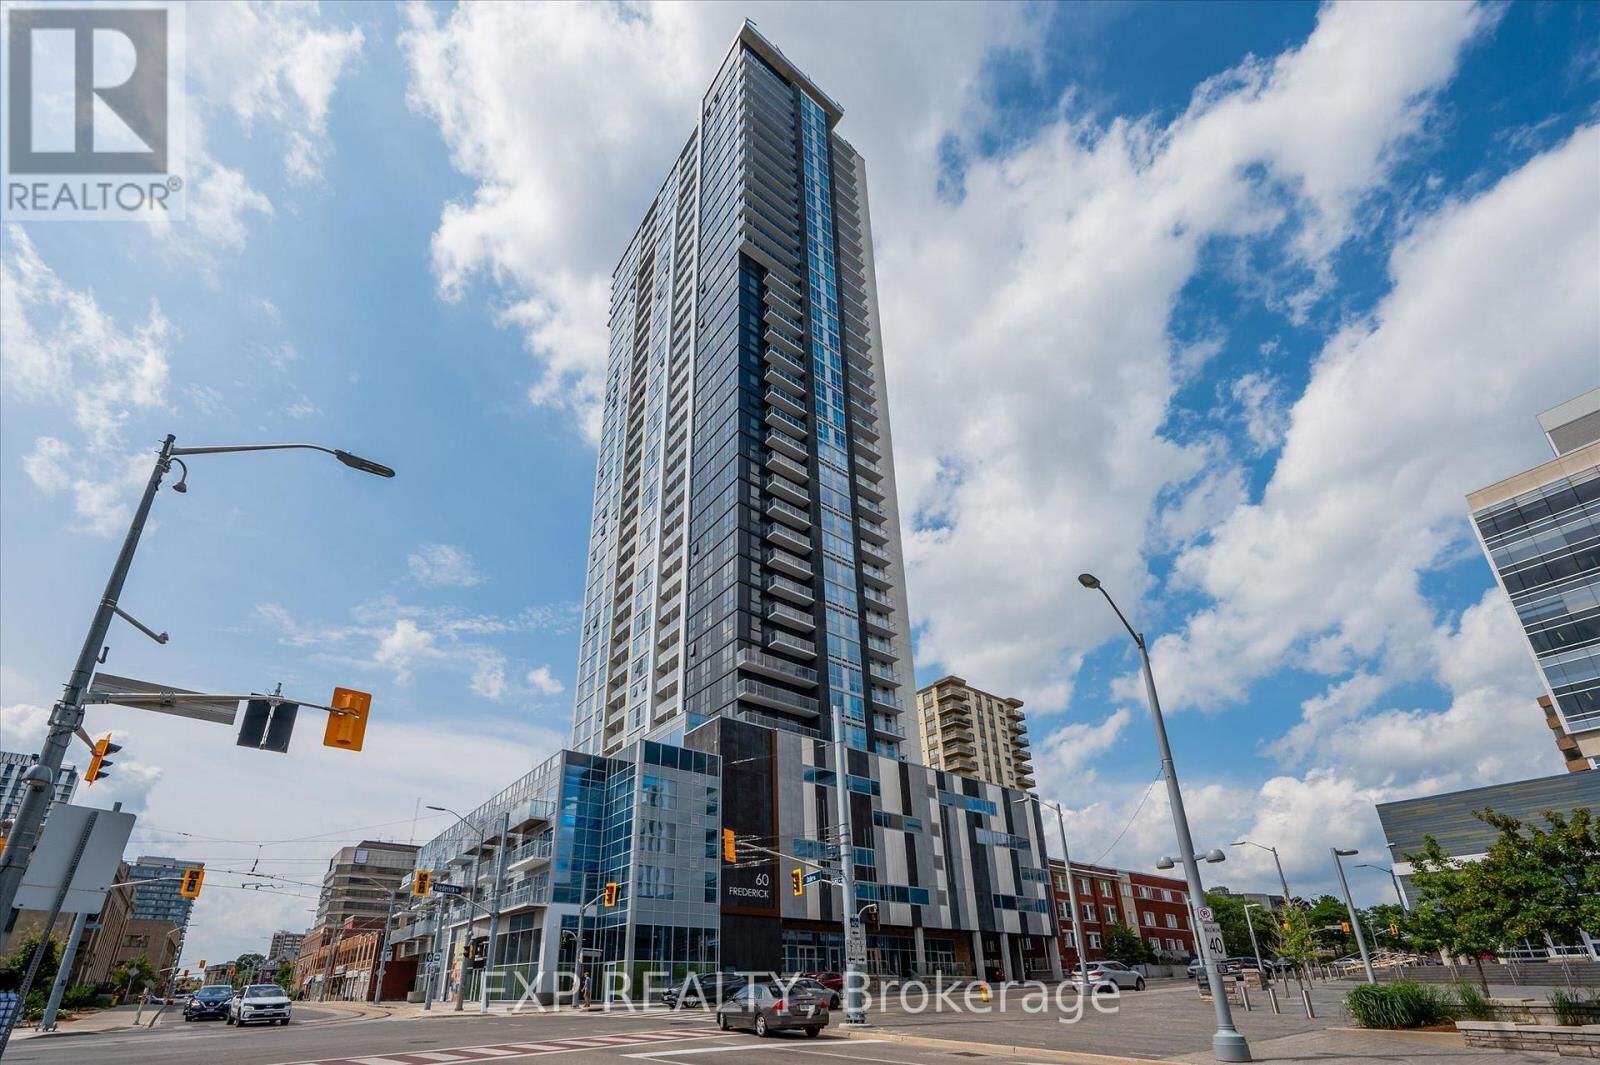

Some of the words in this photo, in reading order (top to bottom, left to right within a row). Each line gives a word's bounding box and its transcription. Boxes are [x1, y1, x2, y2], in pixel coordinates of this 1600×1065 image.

[755, 873, 769, 886] 60
[728, 886, 769, 898] FREDERICK
[1210, 937, 1223, 954] 40
